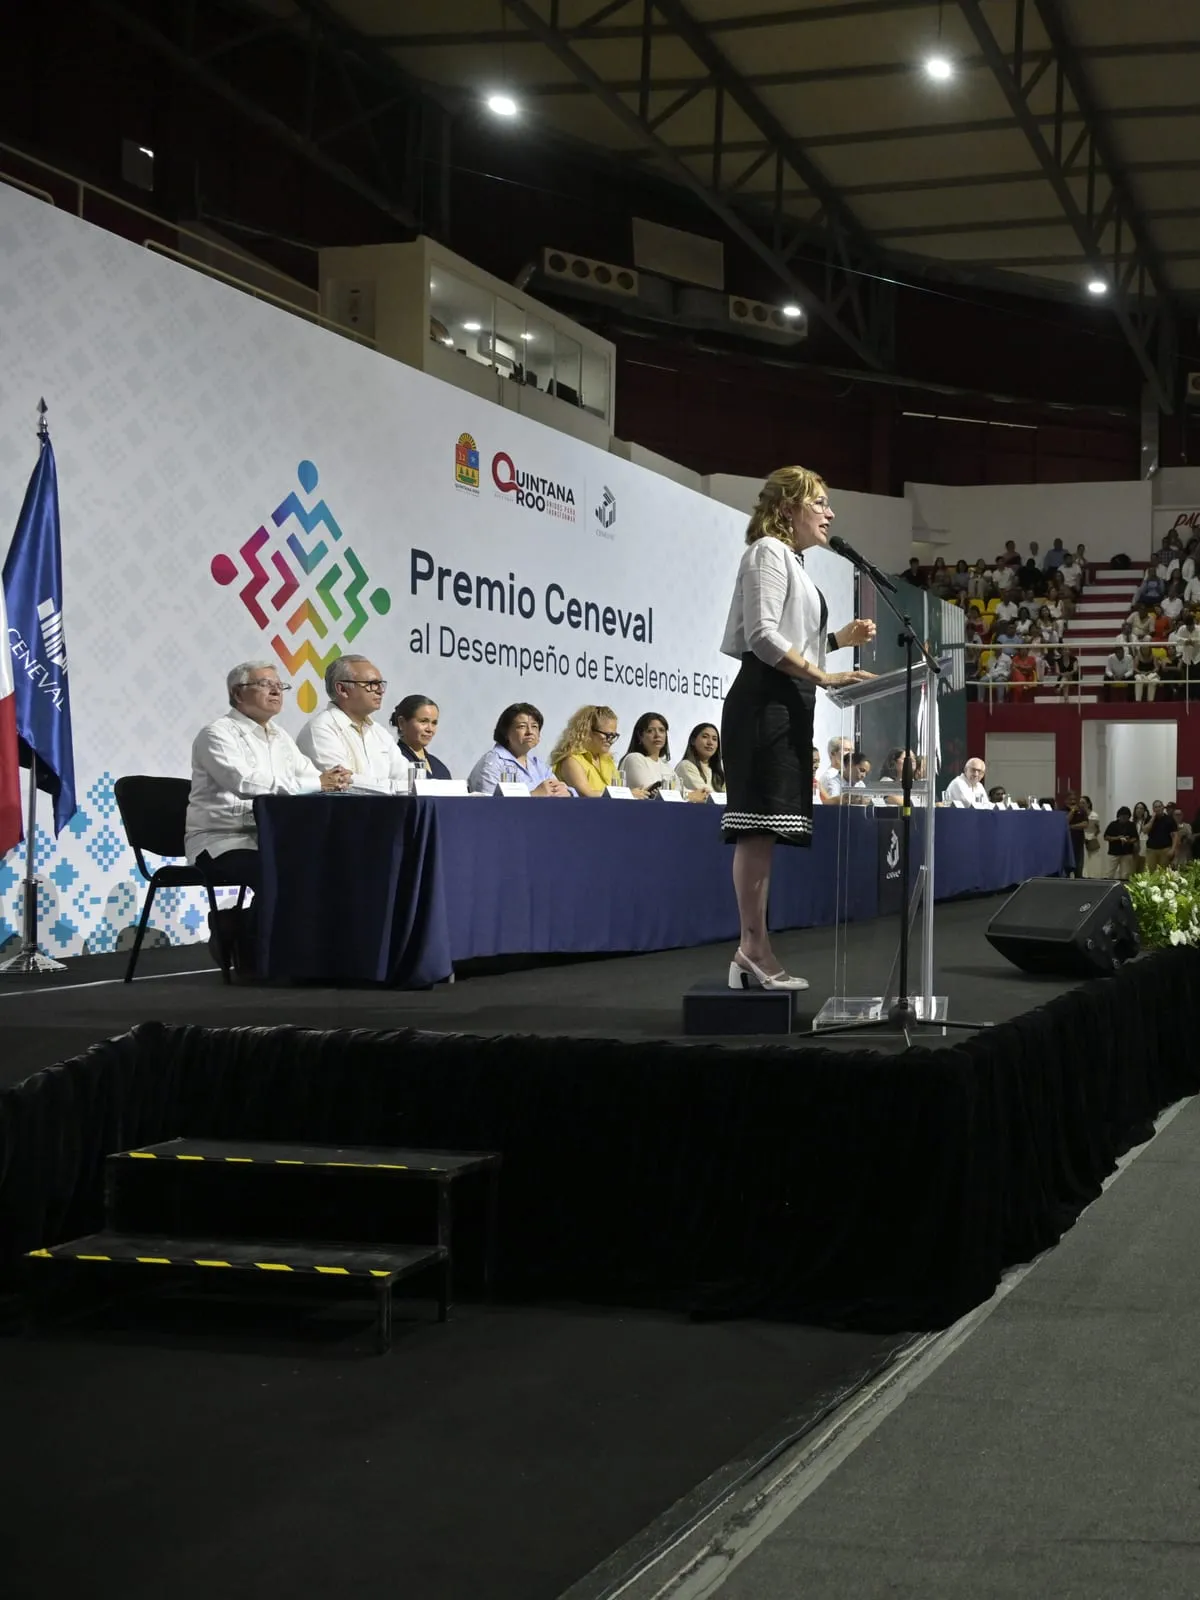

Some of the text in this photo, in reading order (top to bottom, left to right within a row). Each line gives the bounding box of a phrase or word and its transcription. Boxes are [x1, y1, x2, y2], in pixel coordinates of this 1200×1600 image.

[491, 451, 576, 505] QUINTANA
[516, 489, 546, 512] ROO
[410, 547, 653, 644] Premio Ceneval
[7, 627, 65, 712] CENEVAL
[409, 622, 430, 655] al
[439, 625, 570, 676] Desempeño
[575, 651, 598, 680] de
[603, 655, 689, 695] Excelencia
